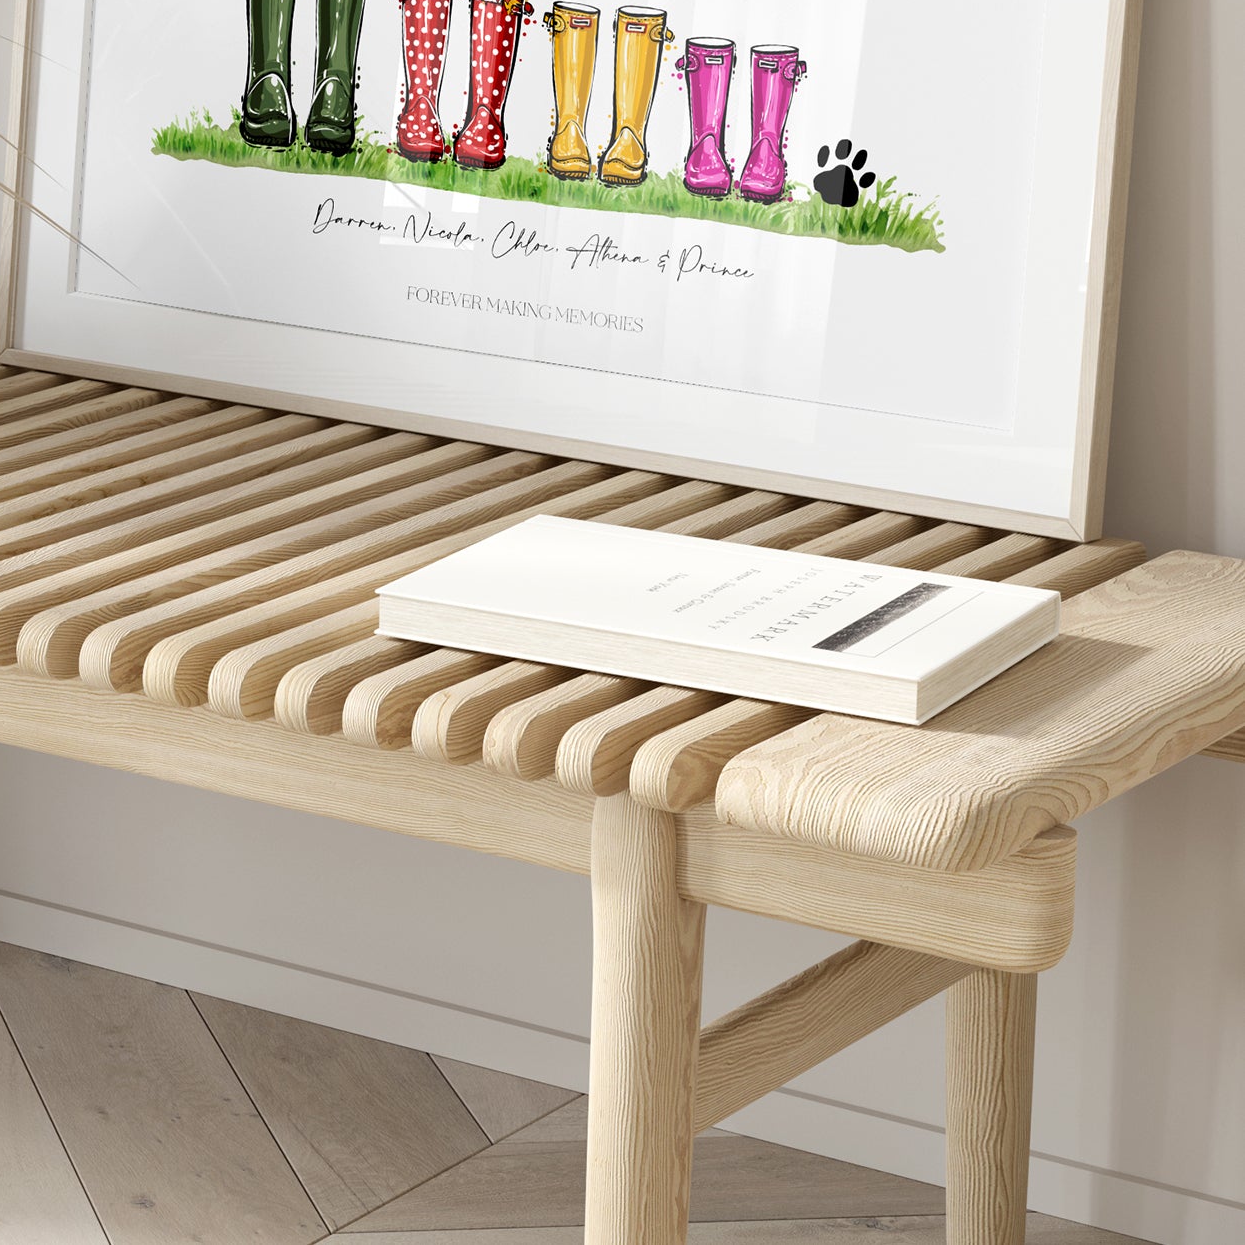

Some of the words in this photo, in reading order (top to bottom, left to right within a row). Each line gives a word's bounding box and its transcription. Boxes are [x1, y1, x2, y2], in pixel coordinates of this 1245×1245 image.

[566, 234, 650, 269] Athena
[657, 249, 669, 273] &
[676, 245, 755, 281] Prince
[406, 285, 483, 311] FOREVER
[486, 297, 552, 320] MAKING
[555, 307, 644, 333] MEMORIES
[750, 574, 883, 642] WATERMARK
